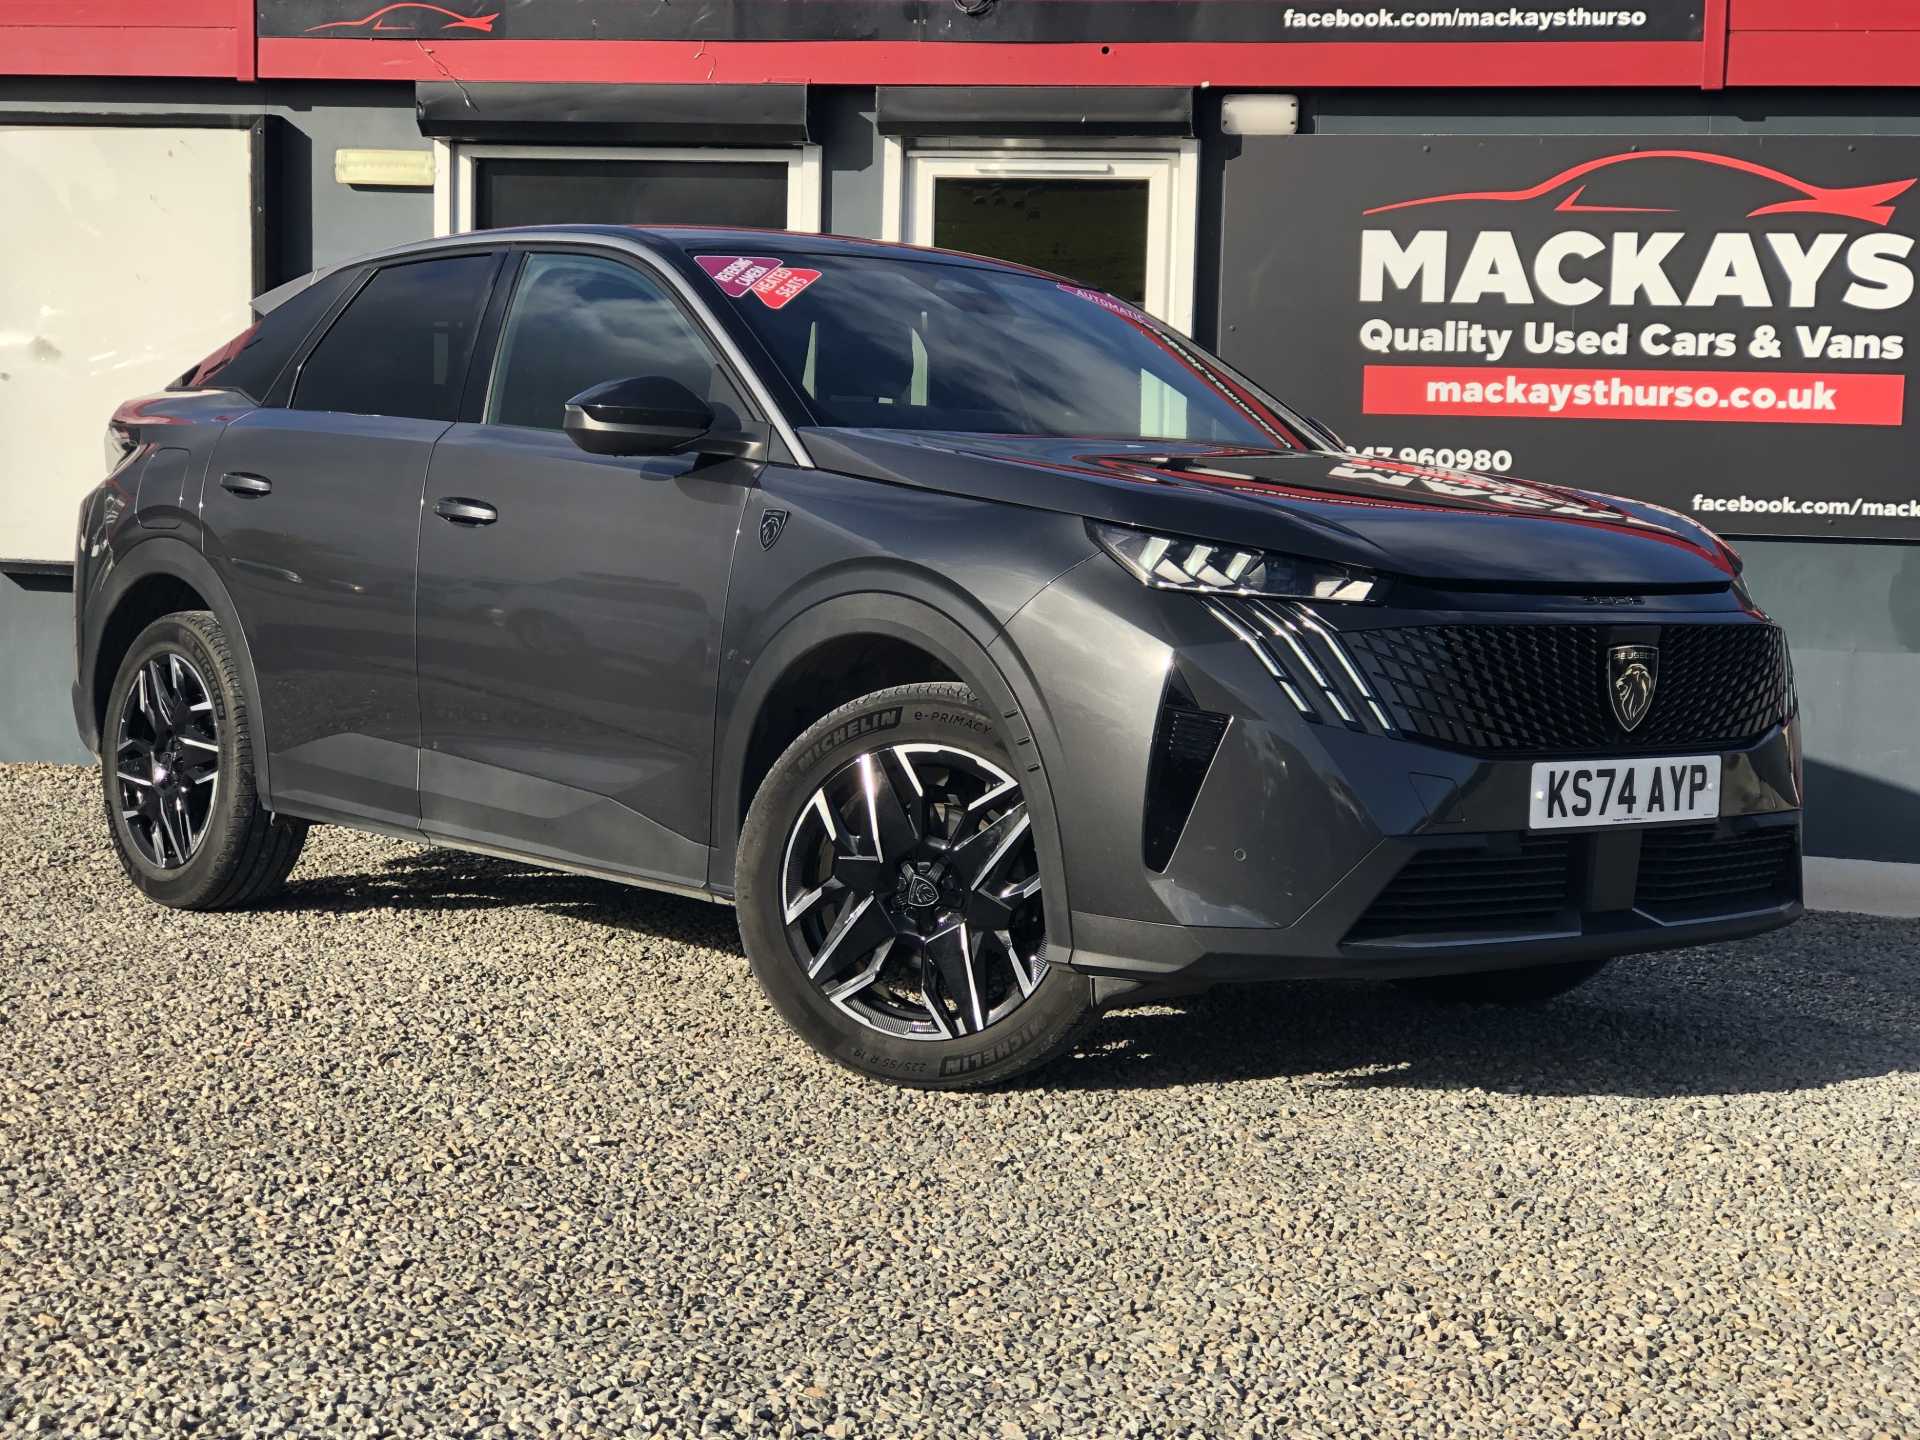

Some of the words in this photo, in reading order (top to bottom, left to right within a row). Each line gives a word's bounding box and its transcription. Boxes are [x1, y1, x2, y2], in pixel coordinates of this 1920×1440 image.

[1284, 7, 1647, 31] facebook.com/mackaysthurso
[755, 269, 793, 294] HEATED
[1359, 229, 1915, 310] MACKAYS
[775, 276, 808, 298] SEATS
[1360, 318, 1512, 361] Quality
[1524, 321, 1629, 356] Used
[1640, 323, 1737, 358] Cars
[1748, 325, 1782, 359] &
[1796, 325, 1904, 360] Vans
[1426, 376, 1837, 412] mackaysthurso.co.uk
[1399, 447, 1513, 472] 960980
[1692, 494, 1920, 517] facebook.com/mack
[798, 709, 899, 768] MICHELIN
[1547, 766, 1637, 819] KS74
[1646, 764, 1708, 813] AYP
